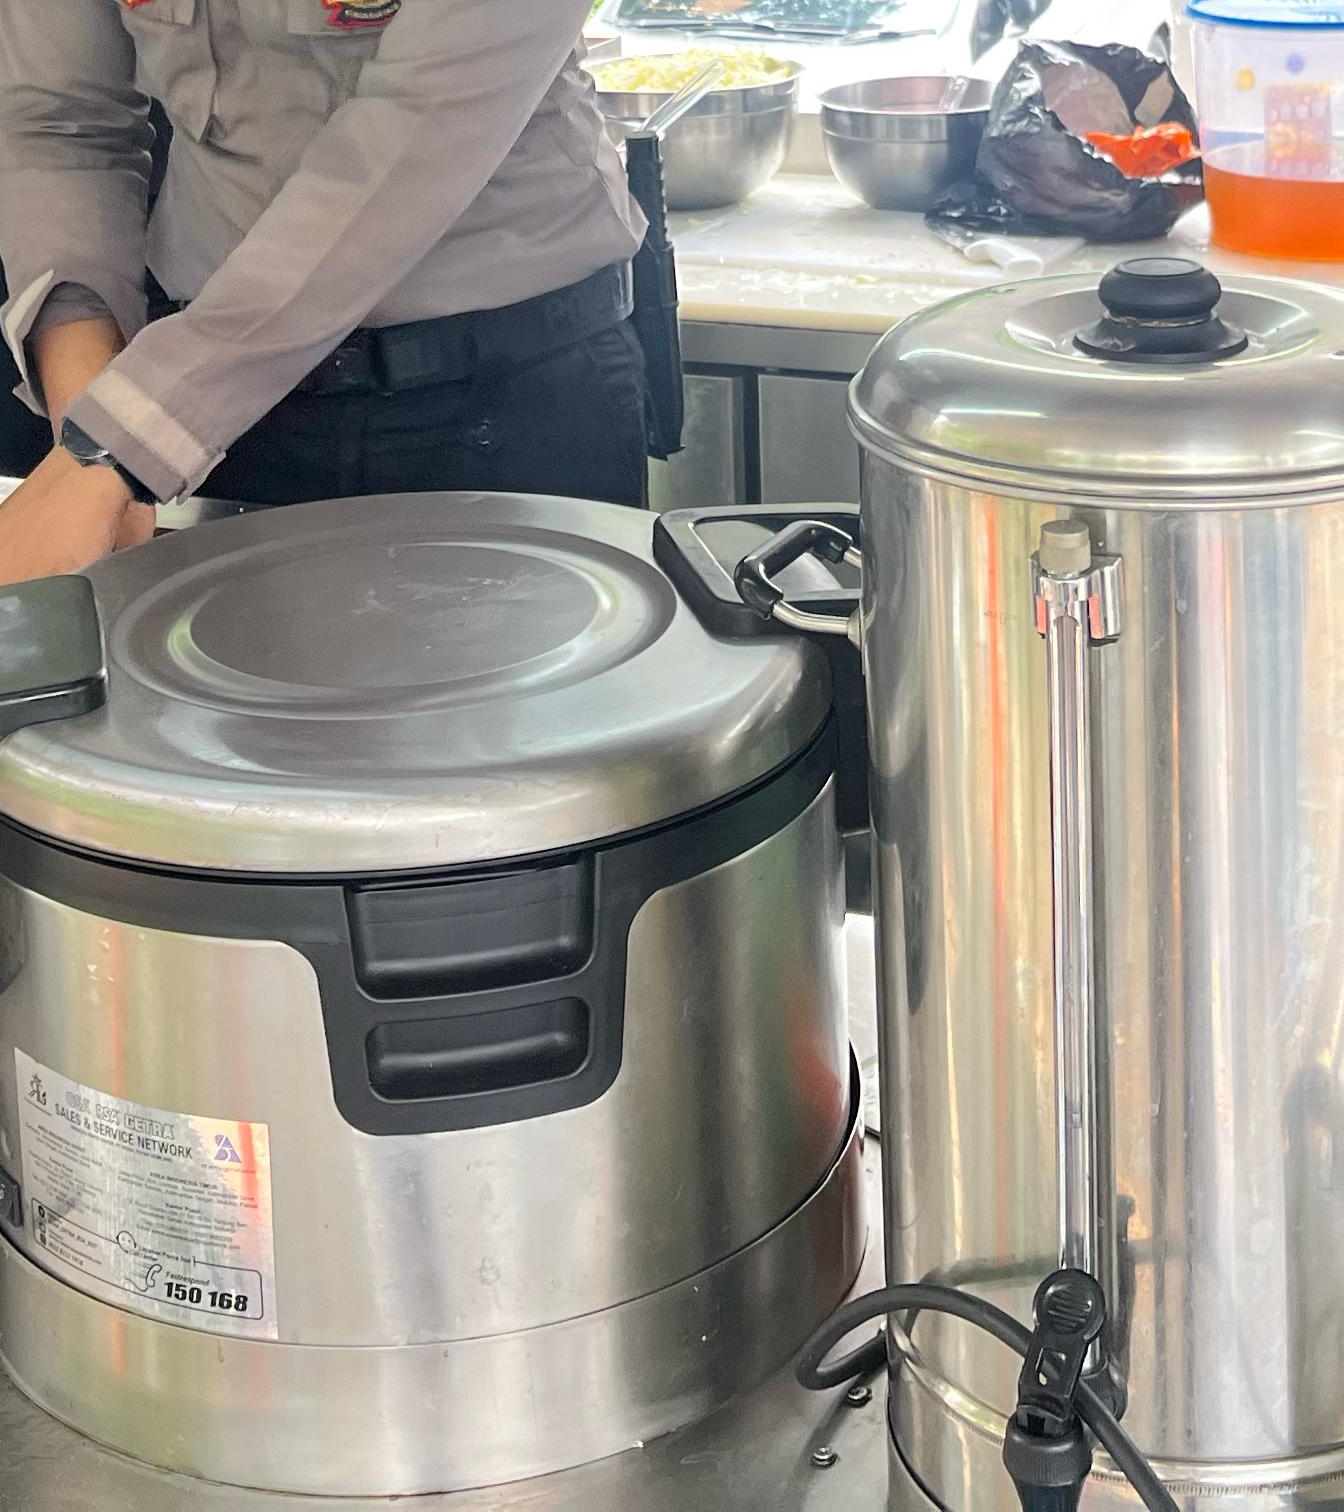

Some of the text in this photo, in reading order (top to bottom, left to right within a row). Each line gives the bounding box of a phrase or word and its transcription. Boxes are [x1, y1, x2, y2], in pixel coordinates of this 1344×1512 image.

[55, 1103, 81, 1126] SALES
[84, 1117, 91, 1130] &
[93, 1121, 134, 1146] SERVICE
[137, 1135, 193, 1159] NETWORK
[164, 1281, 249, 1312] 150 168
